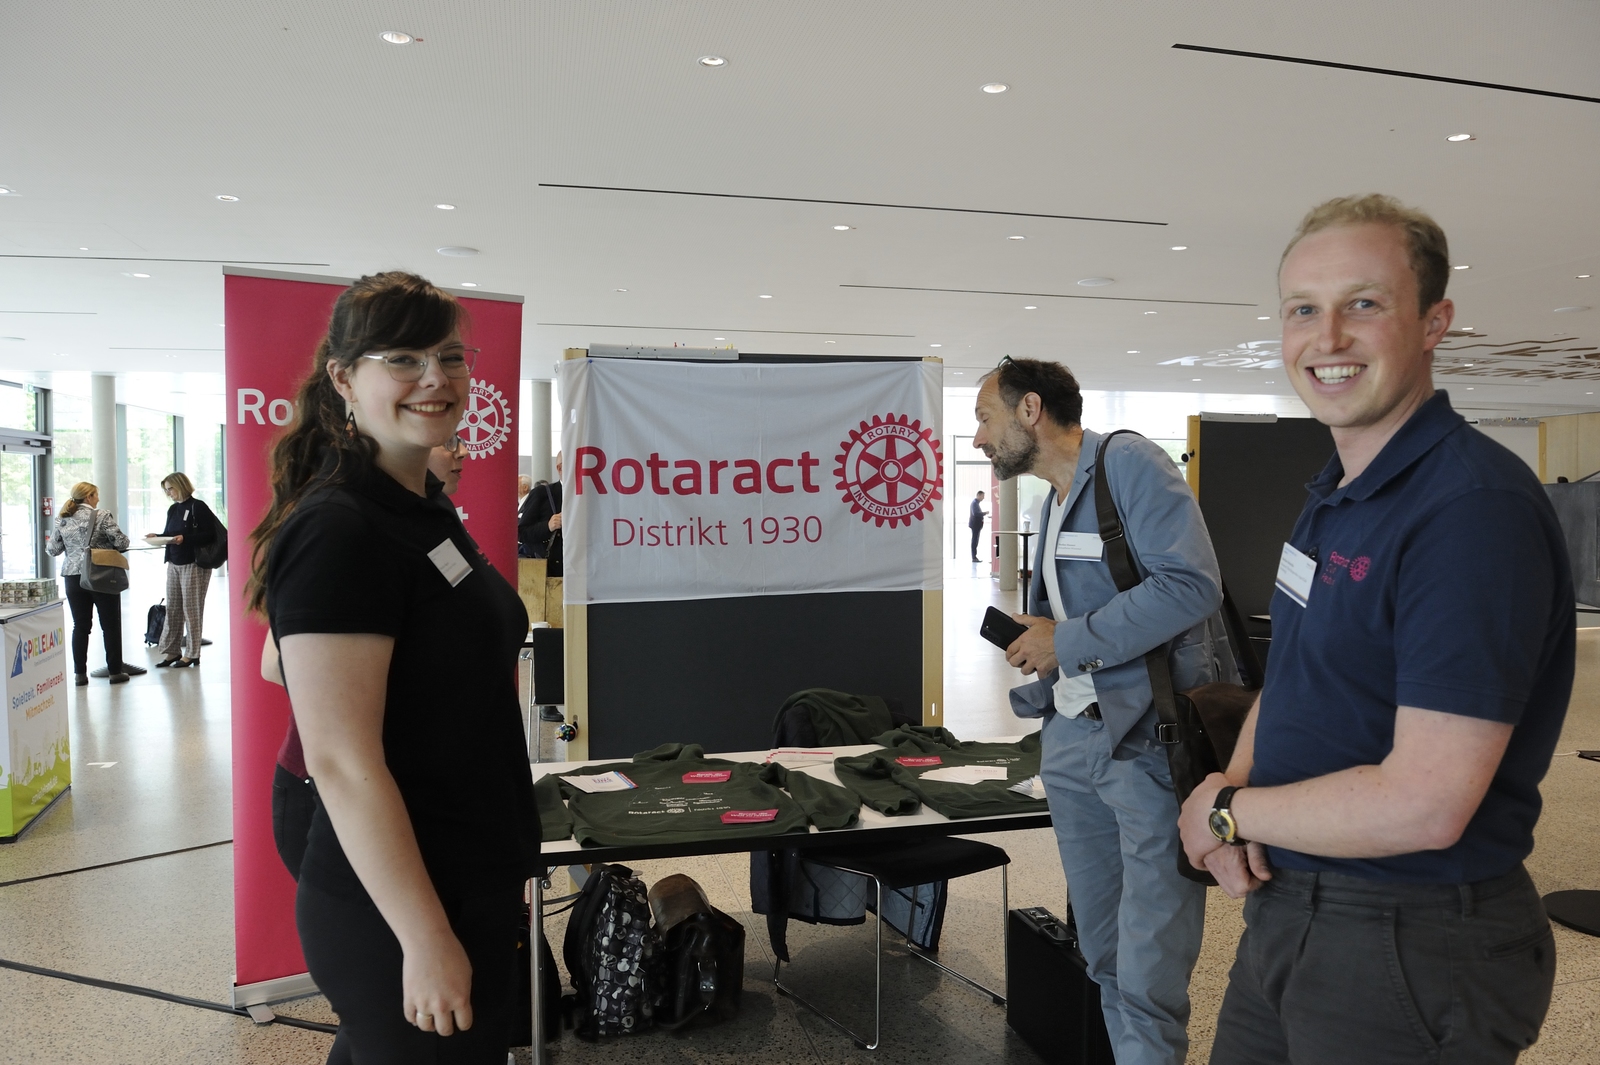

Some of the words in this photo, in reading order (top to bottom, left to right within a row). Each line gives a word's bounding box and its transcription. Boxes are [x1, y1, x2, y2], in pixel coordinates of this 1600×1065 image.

[237, 388, 297, 426] Ro
[466, 432, 502, 451] NATIONAL
[867, 426, 914, 439] ROTARY
[575, 446, 820, 495] Rotaract
[853, 488, 932, 516] INTERNATIONAL
[613, 516, 729, 547] Distrikt
[742, 515, 823, 545] 1930
[23, 627, 63, 661] SPIELELAND
[12, 687, 36, 710] Spielzeit.
[36, 671, 64, 695] Familienzeit.
